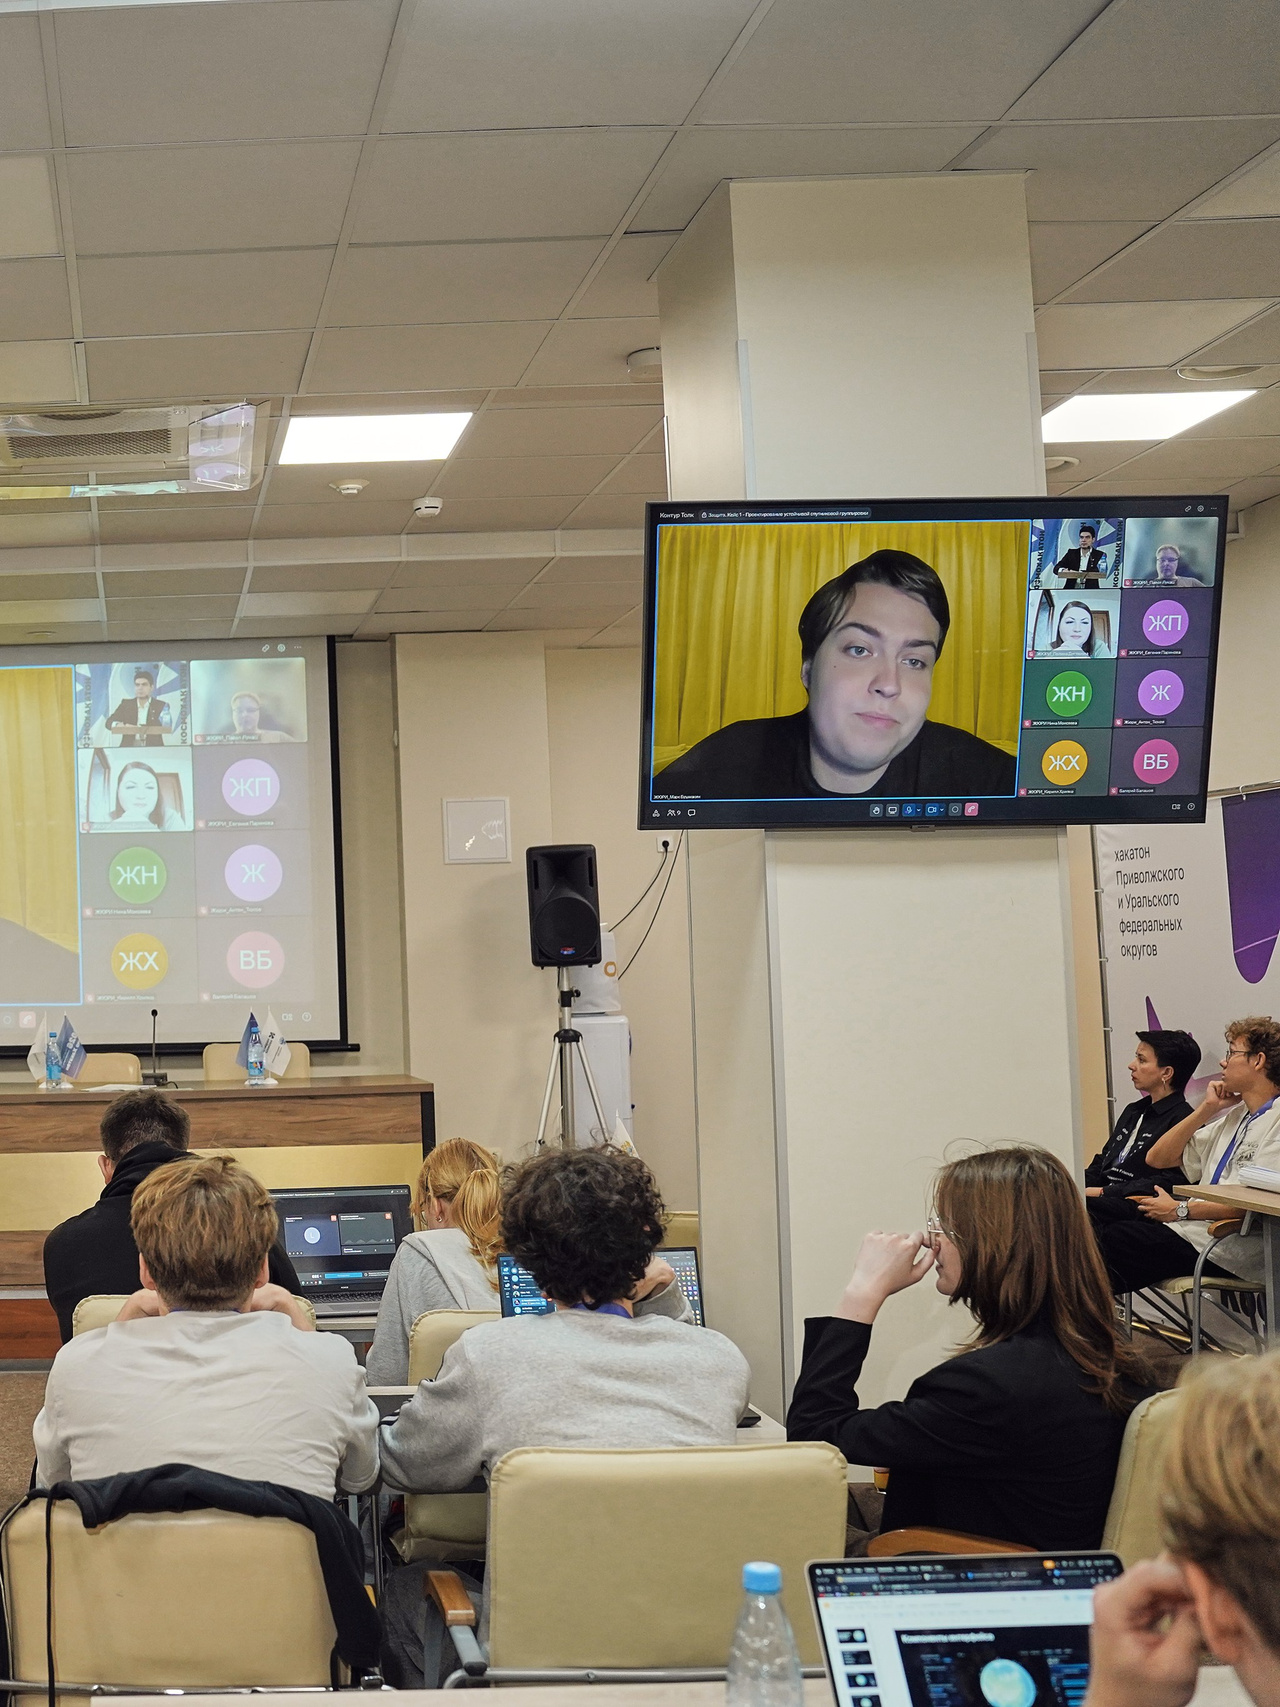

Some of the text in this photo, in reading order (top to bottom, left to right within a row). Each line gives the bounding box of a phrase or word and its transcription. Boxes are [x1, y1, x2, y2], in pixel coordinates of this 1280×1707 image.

[659, 511, 680, 519] Контур
[1147, 614, 1182, 632] ЖП
[1051, 685, 1086, 703] ЖН
[1150, 684, 1172, 701] Ж
[1047, 754, 1081, 771] ЖХ
[1142, 753, 1169, 770] ВБ
[229, 776, 272, 797] ЖП
[1114, 847, 1150, 862] хакатон
[115, 865, 158, 885] ЖН
[240, 863, 266, 884] Ж
[1116, 867, 1185, 887] Приволжского
[1118, 892, 1180, 911] и Уральского
[1119, 918, 1183, 936] федеральных
[239, 949, 273, 971] ВБ
[1120, 942, 1158, 960] округов
[118, 951, 160, 972] ЖХ
